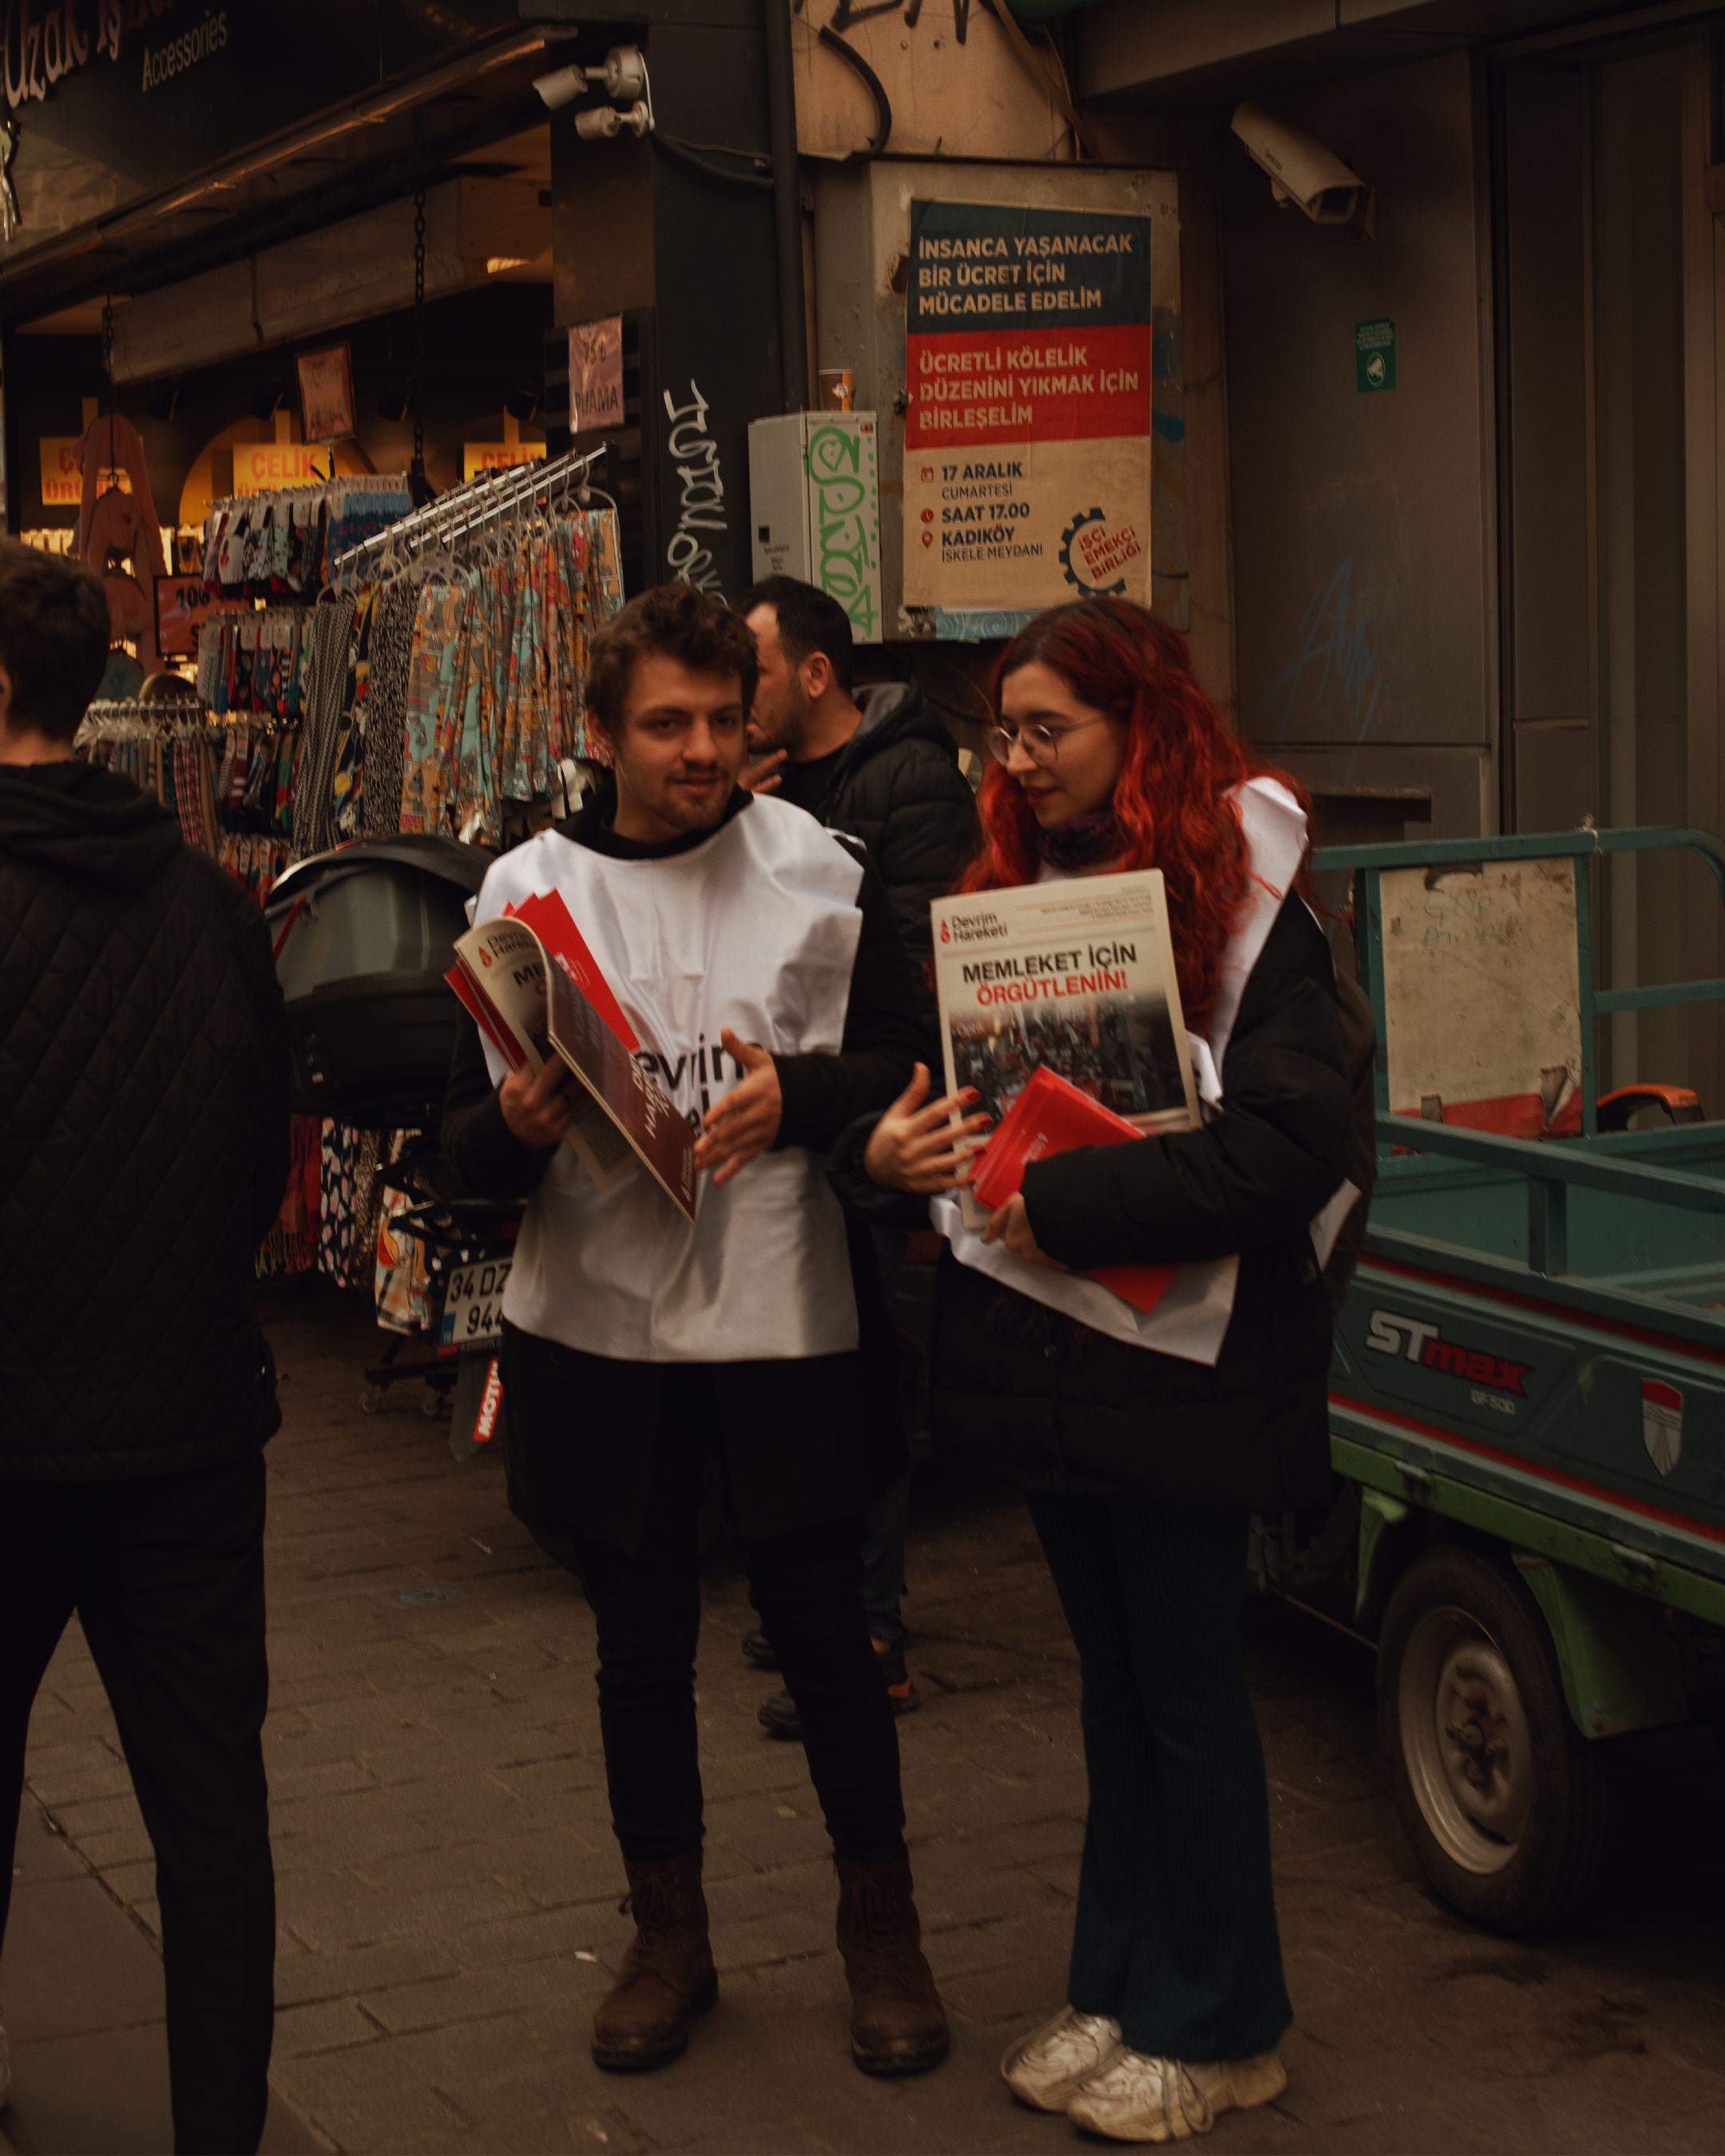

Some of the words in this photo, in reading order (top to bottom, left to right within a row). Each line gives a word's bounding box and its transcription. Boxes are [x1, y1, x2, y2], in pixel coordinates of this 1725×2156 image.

[142, 8, 228, 93] Accessories
[919, 236, 1009, 260] İNSANCA
[1013, 233, 1132, 259] YAŞANACAK
[919, 264, 952, 287] BİR
[957, 262, 1021, 286] ÜCRET
[1027, 260, 1065, 287] İÇİN
[919, 291, 1027, 315] MÜCADELE
[1031, 285, 1102, 311] EDELİM
[920, 347, 1001, 375] ÜCRETLİ
[1007, 343, 1088, 370] KÖLELİK
[920, 374, 1014, 402] DÜZENİNİ
[1018, 373, 1095, 397] YIKMAK
[1100, 368, 1139, 396] İÇİN
[920, 401, 1033, 431] BİRLEŞELİM
[251, 447, 317, 482] ÇELİK
[942, 465, 958, 482] 17
[962, 462, 1023, 481] ARALIK
[942, 481, 1013, 501] CUMARTESİ
[942, 505, 985, 524] SAAT
[989, 502, 1030, 520] 17.00
[942, 524, 1015, 548] KADIKÖY
[988, 543, 1043, 559] MEYDANI
[962, 949, 1081, 985] MEMLEKET
[1088, 941, 1137, 971] İÇİN
[977, 968, 1128, 1006] ÖRGÜTLENİN!
[450, 1268, 475, 1302] 34
